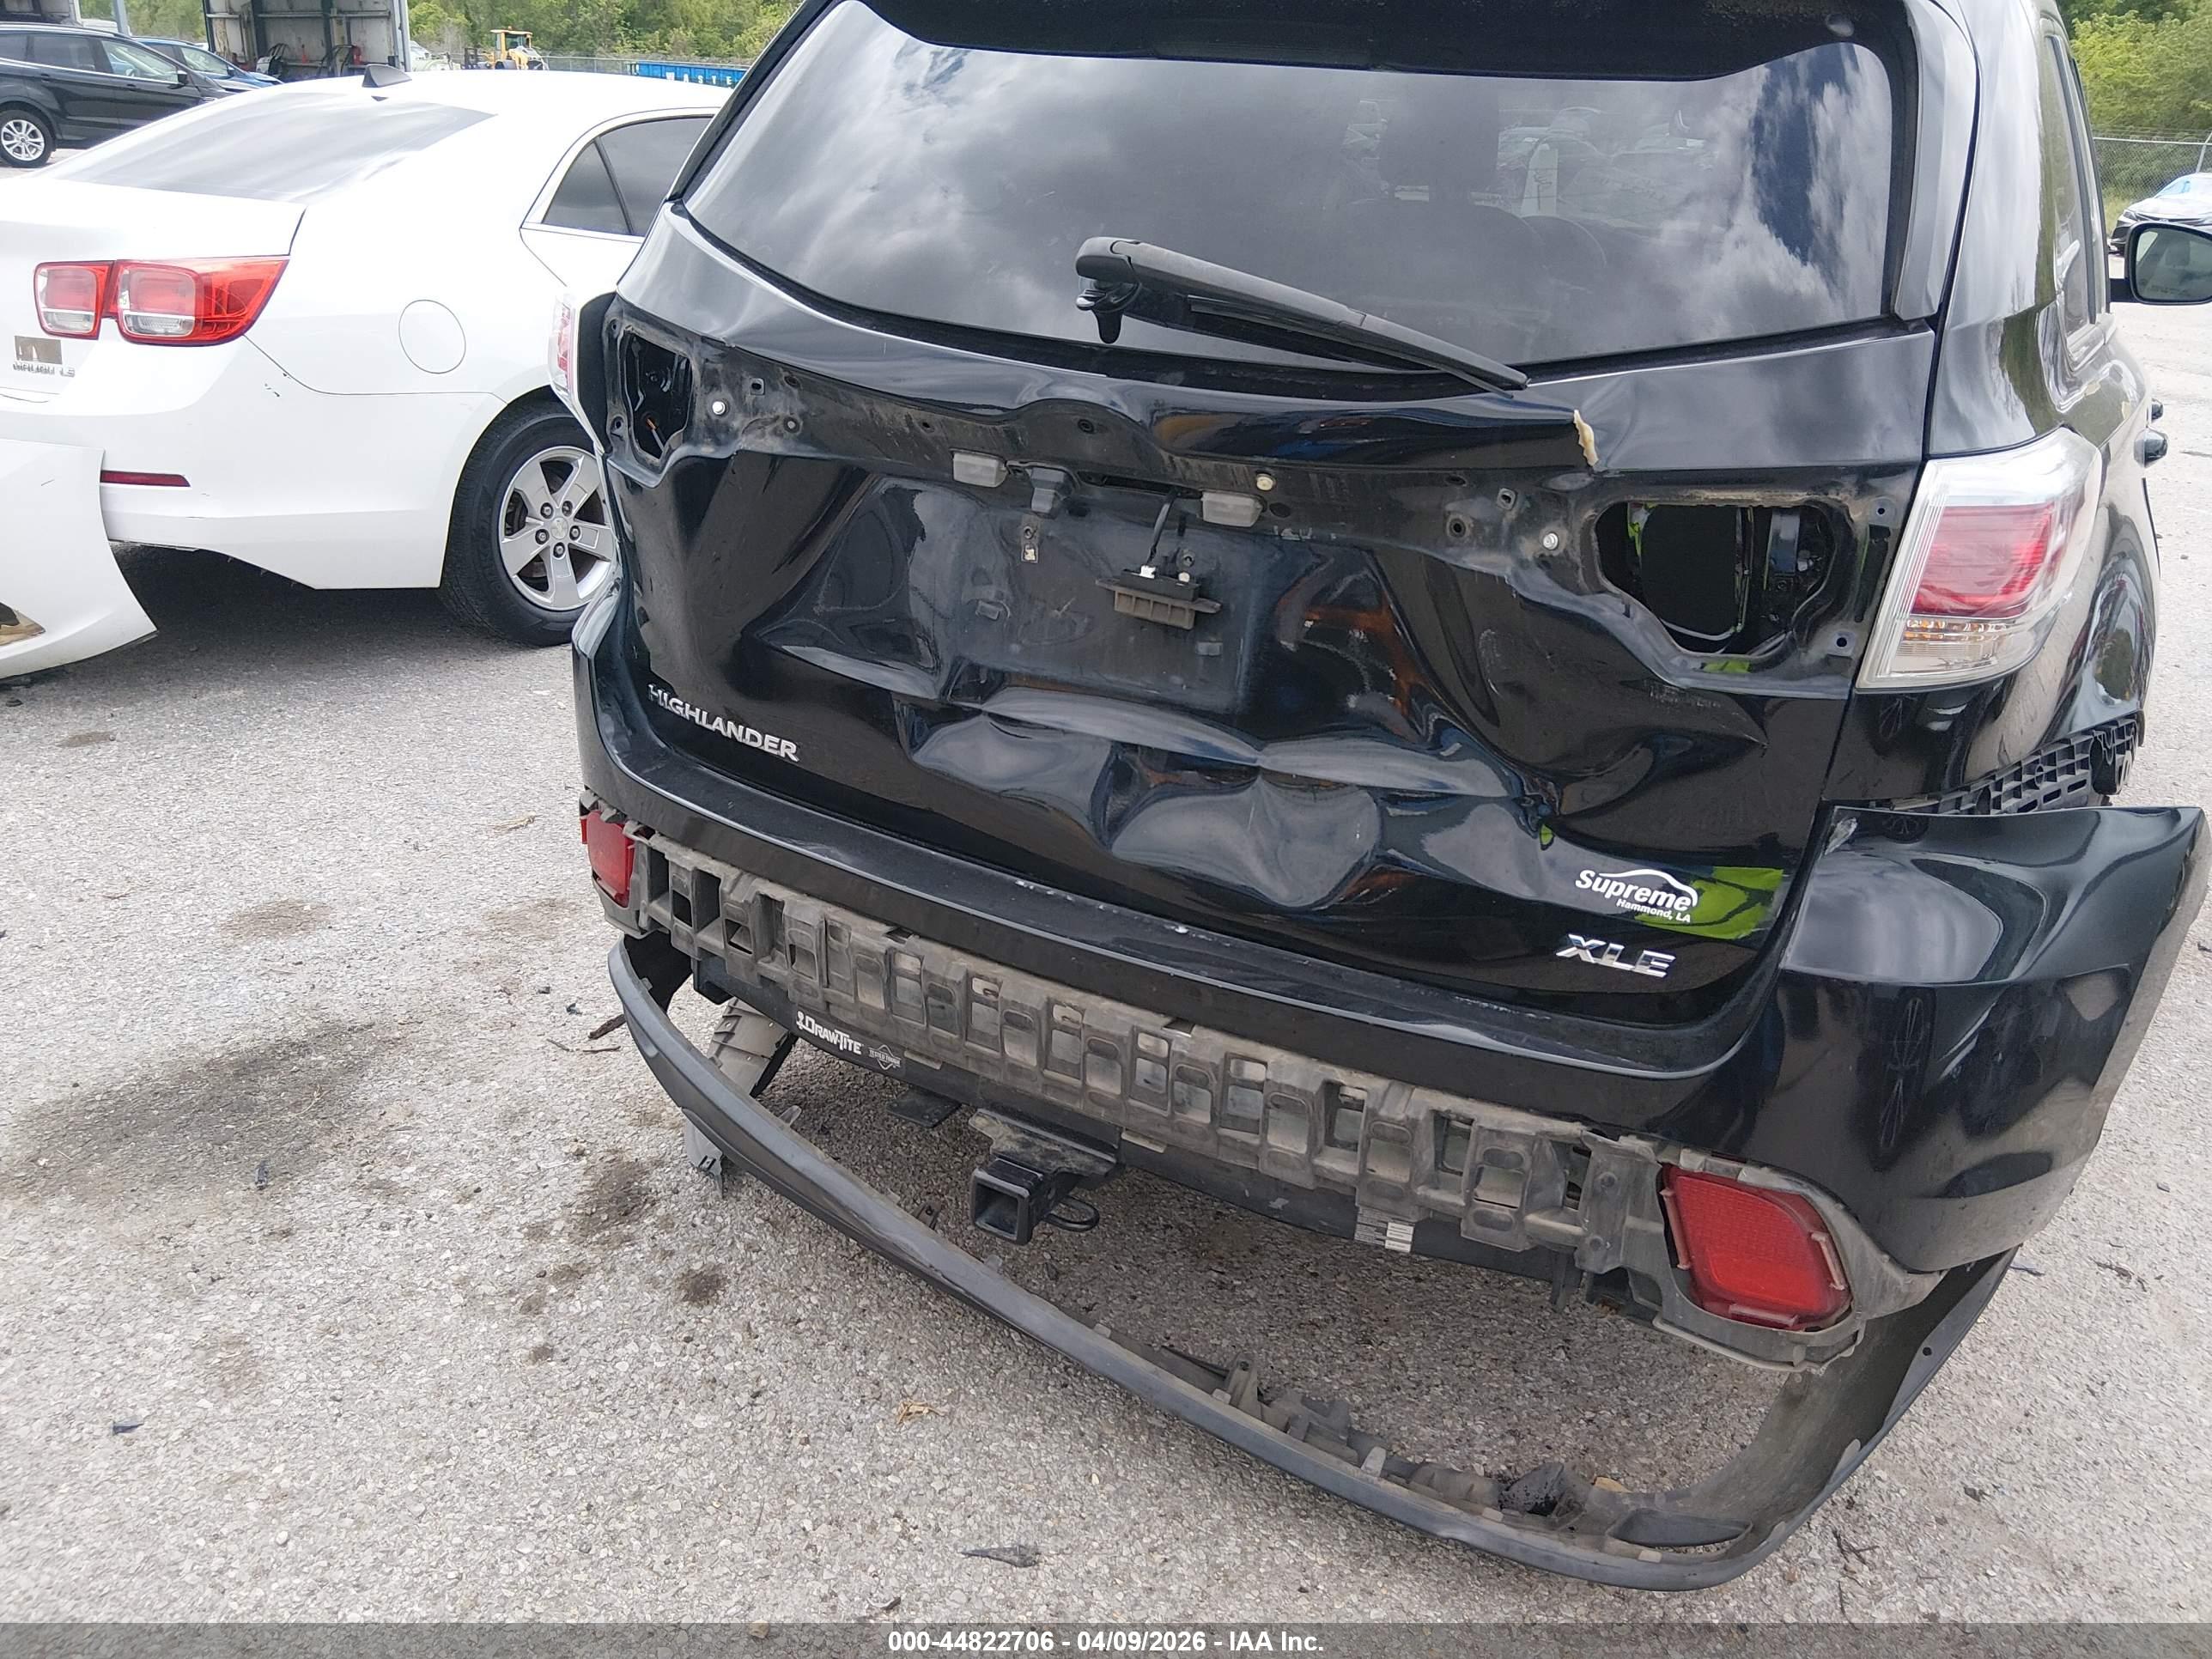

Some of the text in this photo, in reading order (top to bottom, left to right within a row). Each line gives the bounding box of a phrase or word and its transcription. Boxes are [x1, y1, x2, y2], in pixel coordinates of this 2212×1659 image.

[665, 71, 732, 85] WASTE
[647, 684, 799, 763] HIGHLANDER
[1575, 870, 1692, 911] Supreme
[1616, 898, 1691, 922] Hammond, LA
[1556, 933, 1676, 978] XLE
